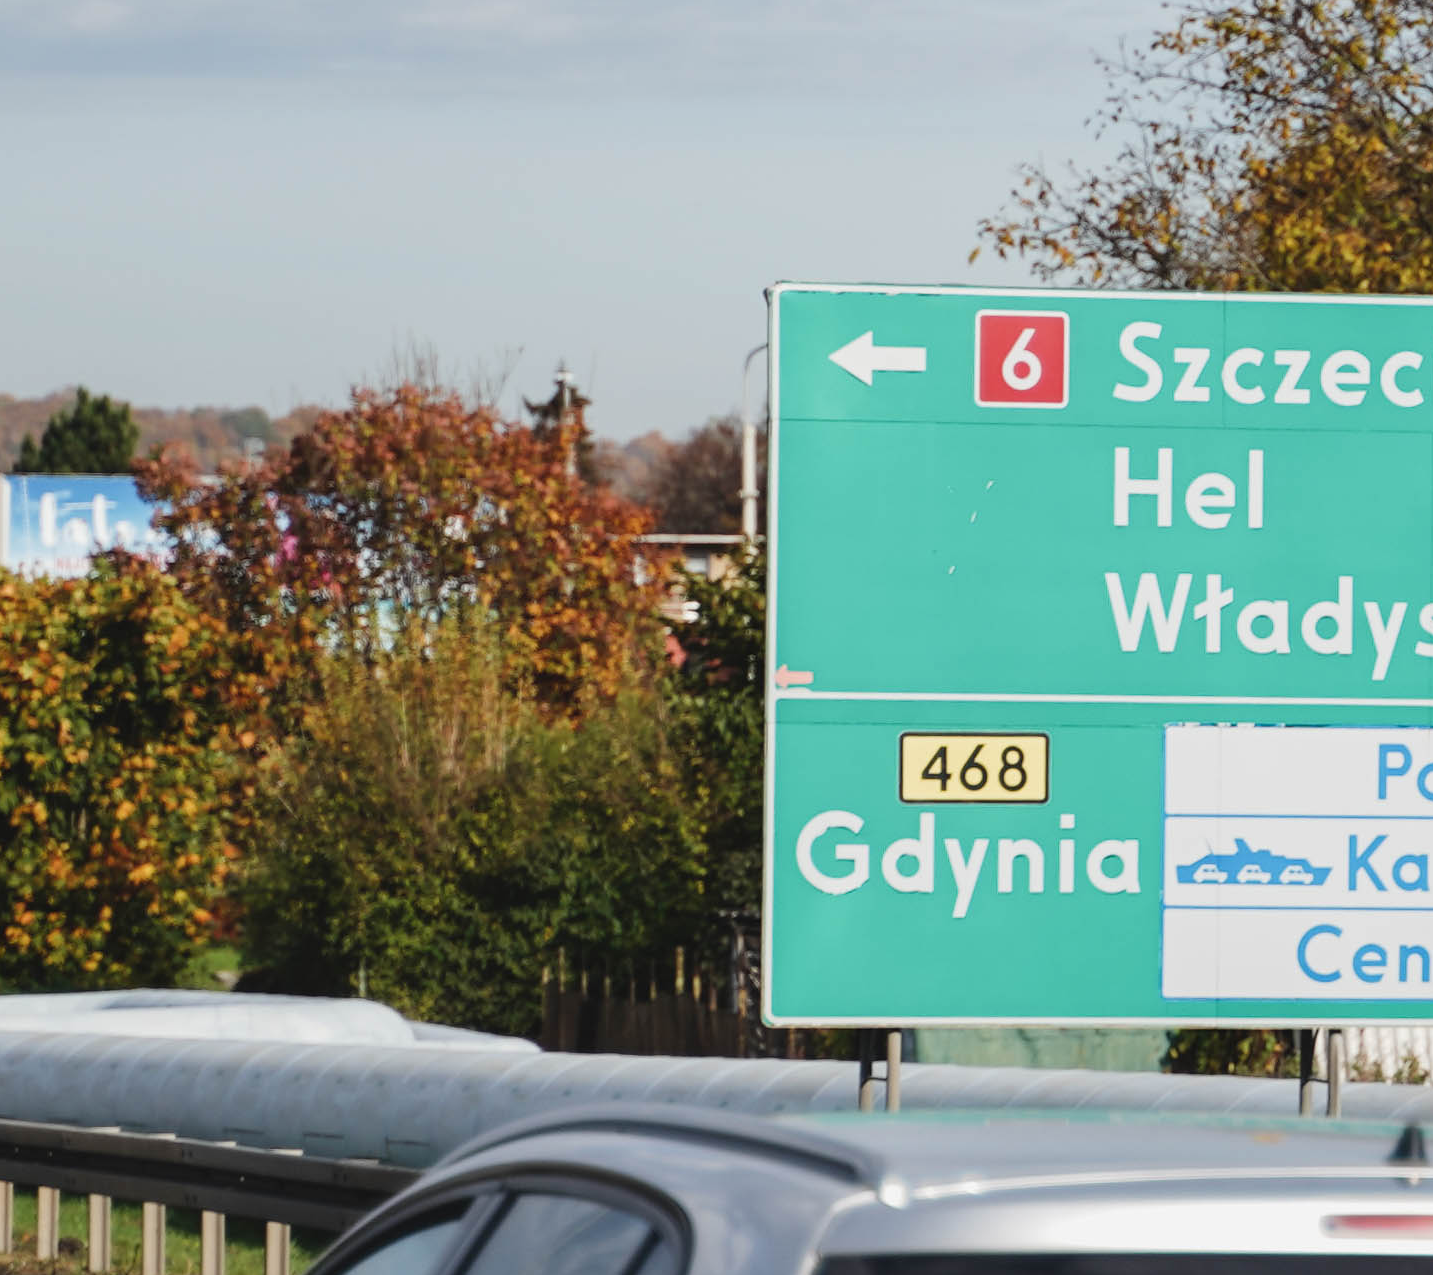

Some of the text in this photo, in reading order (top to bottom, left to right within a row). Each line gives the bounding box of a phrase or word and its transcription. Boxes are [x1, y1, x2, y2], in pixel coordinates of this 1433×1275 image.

[1002, 328, 1042, 390] 6
[1114, 447, 1264, 529] Hel
[922, 744, 1027, 792] 468
[796, 810, 1141, 918] Gdynia
